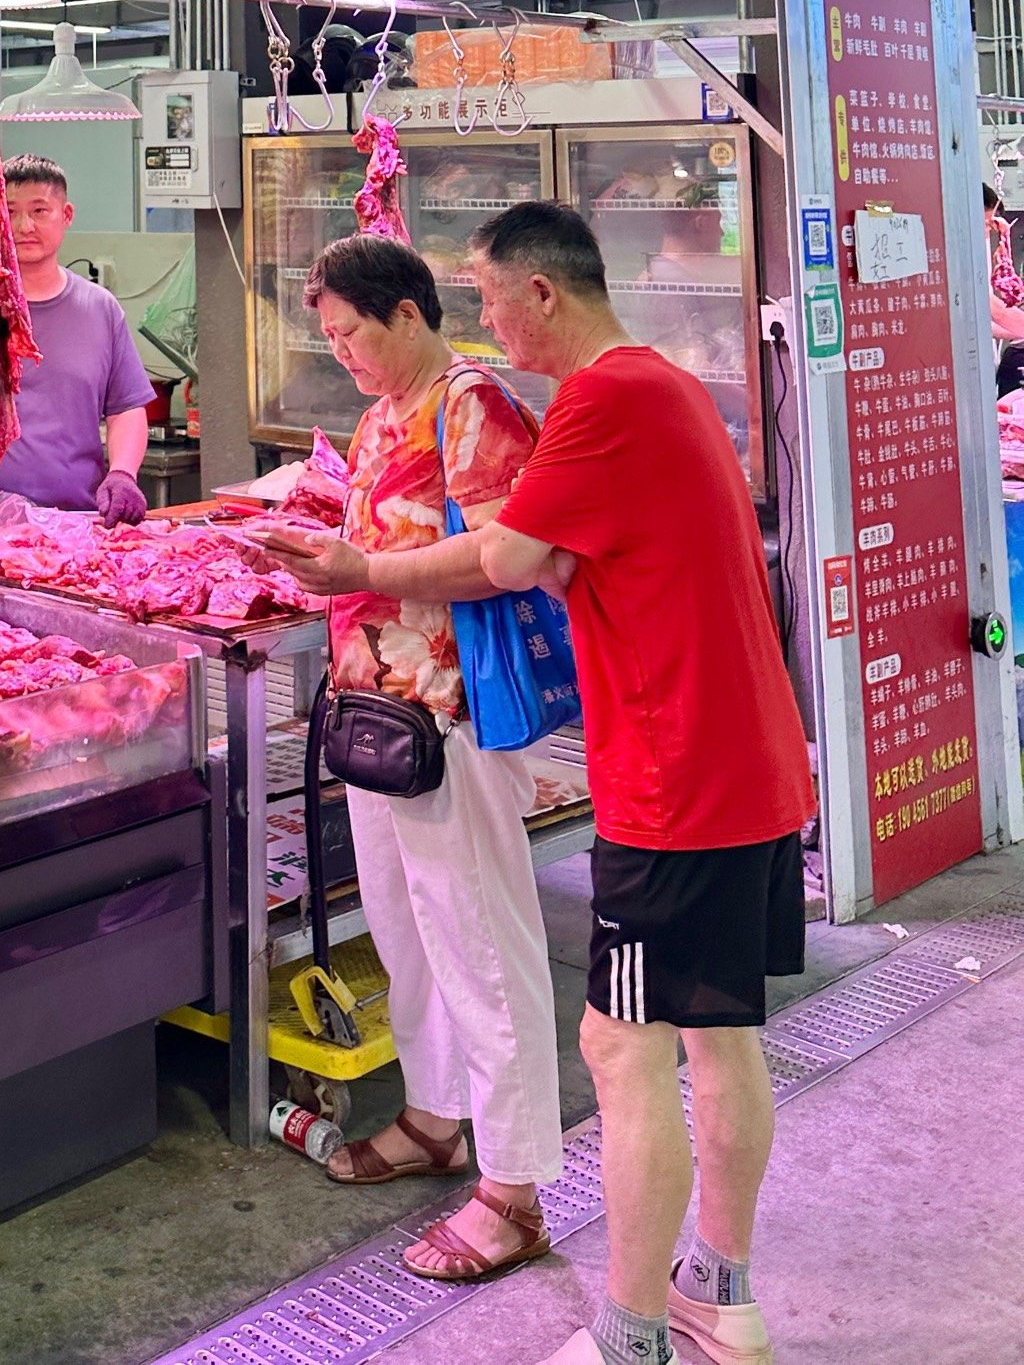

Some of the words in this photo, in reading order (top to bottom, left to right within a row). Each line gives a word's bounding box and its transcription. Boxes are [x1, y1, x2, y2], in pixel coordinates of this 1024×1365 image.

[402, 98, 508, 121] 多功能展示柜
